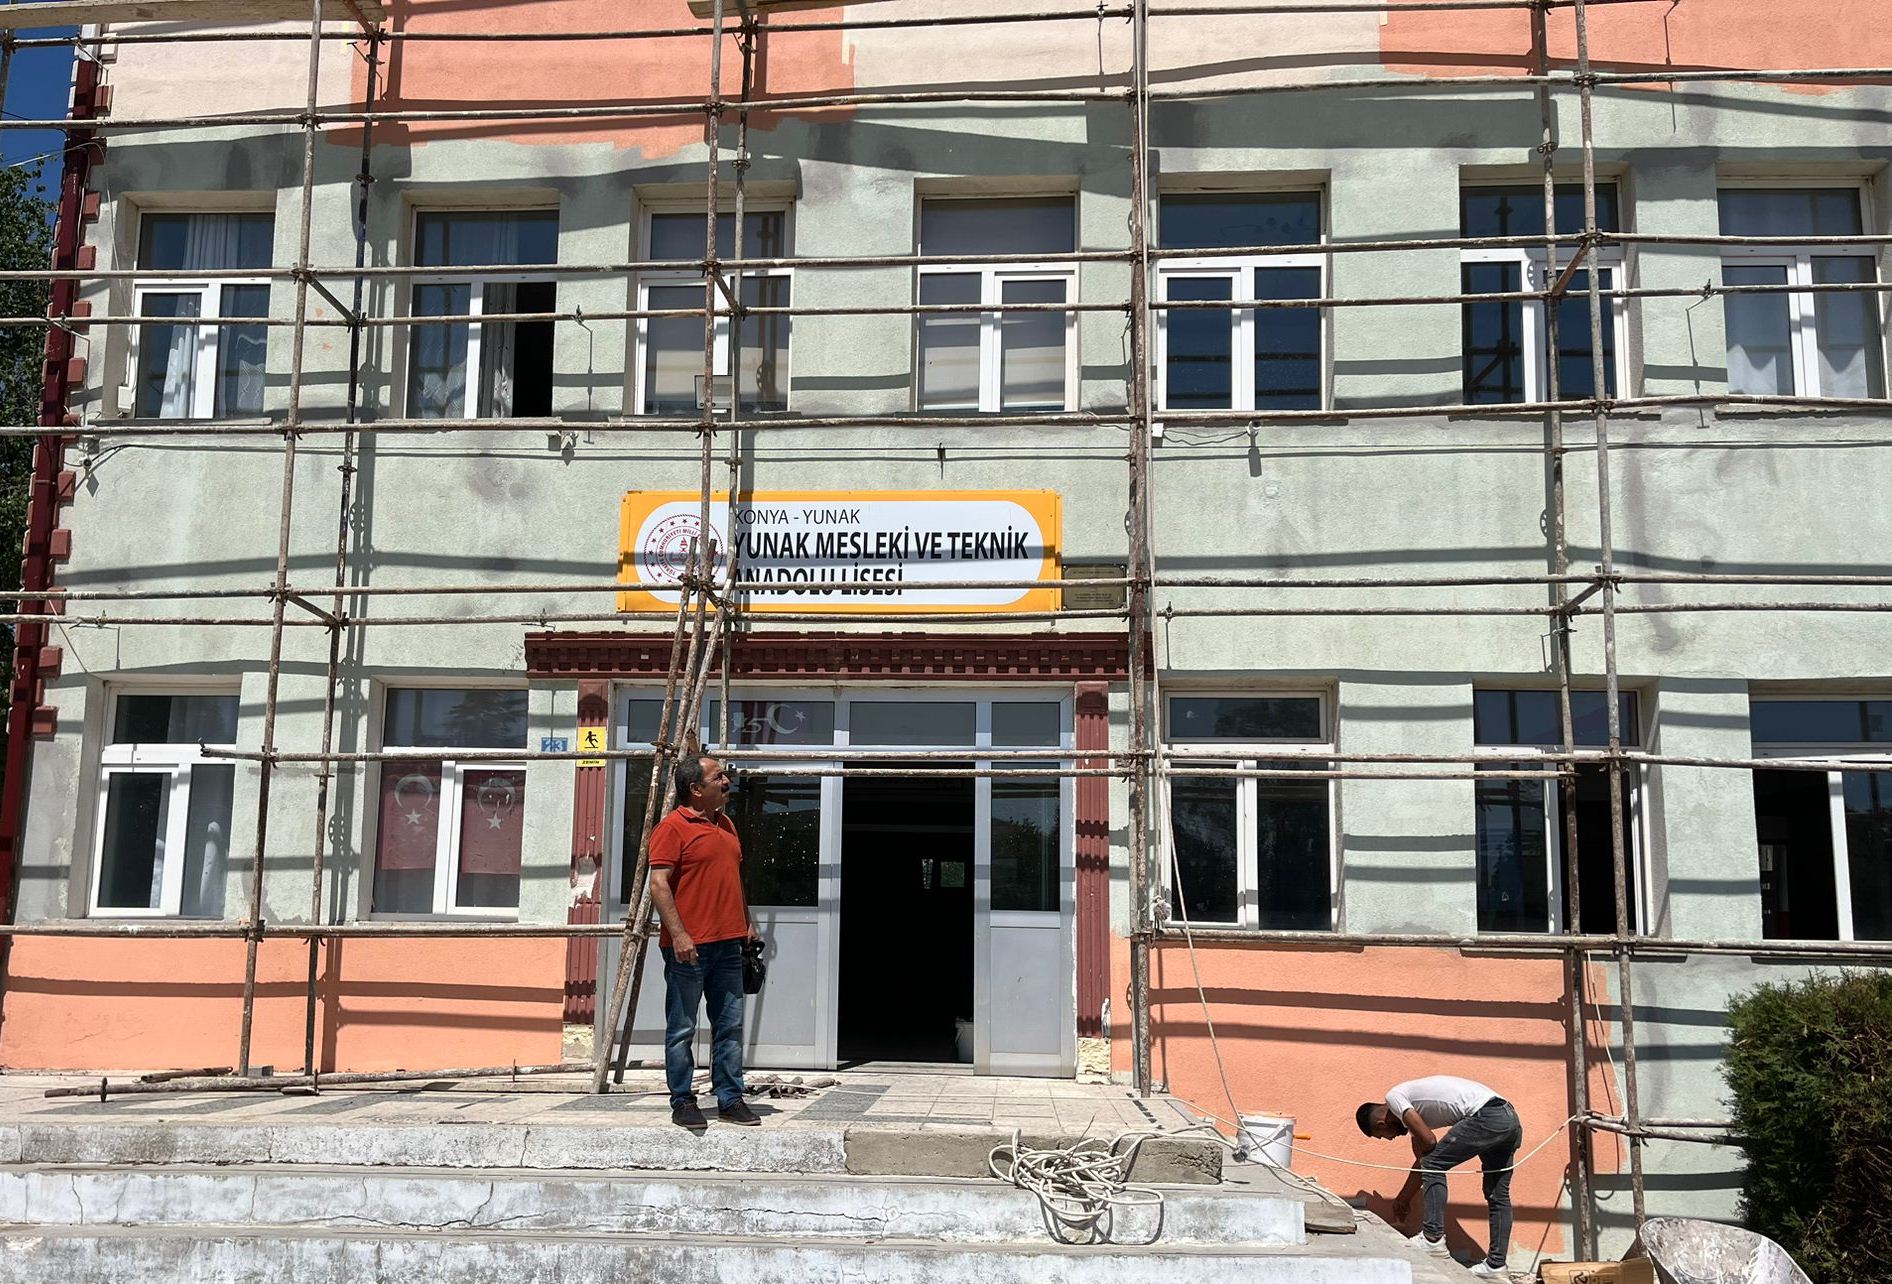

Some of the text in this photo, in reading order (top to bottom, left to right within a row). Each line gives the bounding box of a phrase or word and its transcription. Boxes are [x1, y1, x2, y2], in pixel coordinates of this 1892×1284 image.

[735, 509, 789, 525] KONYA
[802, 509, 861, 525] YUNAK
[734, 525, 1029, 559] YUNAK MESLEKİ VE TEKNİK
[841, 561, 903, 596] LİSESİ
